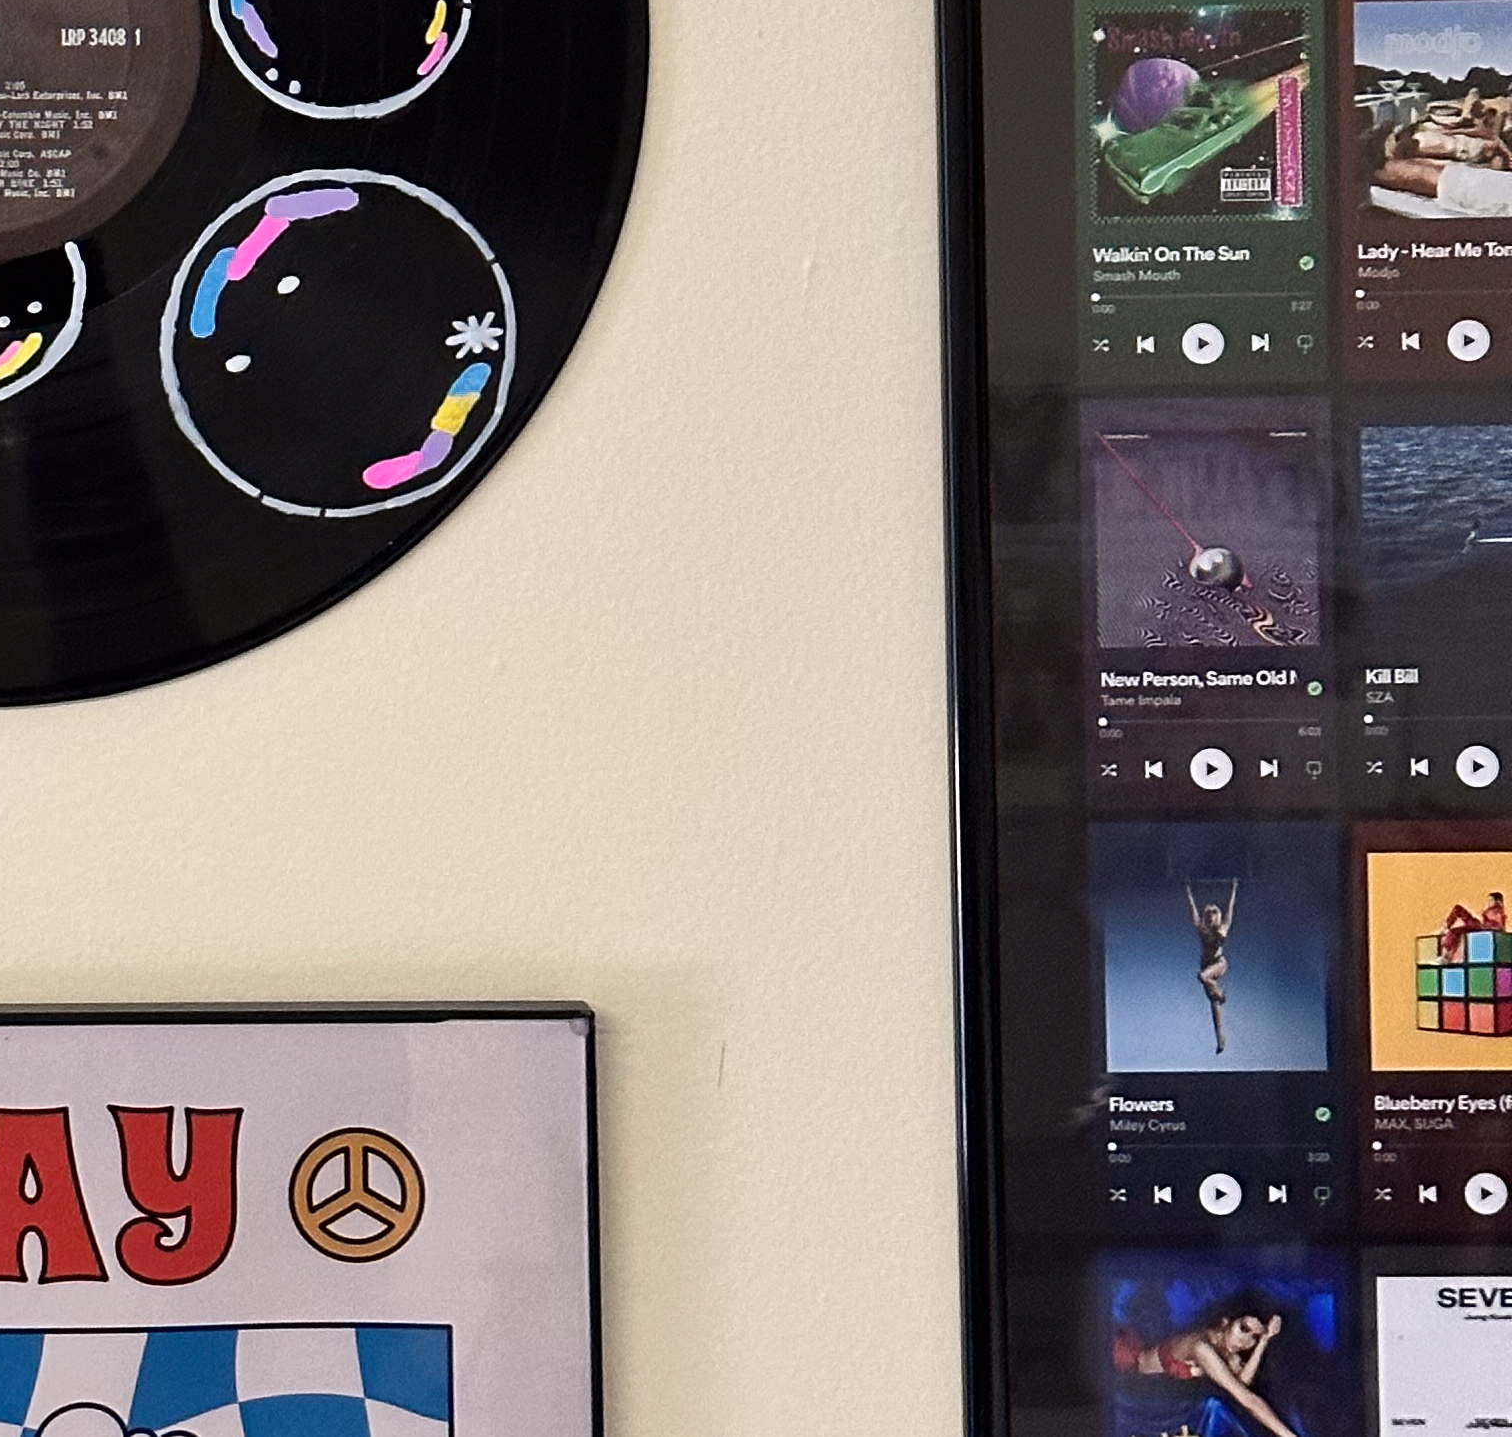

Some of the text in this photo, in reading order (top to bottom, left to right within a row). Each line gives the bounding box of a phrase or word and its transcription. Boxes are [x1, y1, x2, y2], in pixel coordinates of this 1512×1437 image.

[61, 28, 141, 46] LRP 3408 1
[1092, 245, 1250, 263] Walkin' On The Sun
[1358, 243, 1399, 262] Lady
[1411, 243, 1451, 258] Hear
[1454, 243, 1482, 258] Me
[1093, 269, 1181, 282] Smash Mouth
[1100, 672, 1139, 687] New
[1142, 671, 1204, 689] Person,
[1206, 670, 1253, 686] Same
[1256, 670, 1292, 686] Old
[1365, 668, 1419, 684] Kill Bill
[1100, 695, 1135, 706] Tame
[1366, 691, 1394, 703] SZA
[1109, 1096, 1174, 1112] Flowers
[1374, 1095, 1456, 1114] Blueberry
[1457, 1095, 1497, 1114] Eyes
[1110, 1119, 1186, 1133] Miley Cyrus
[1414, 1118, 1454, 1130] SUGA
